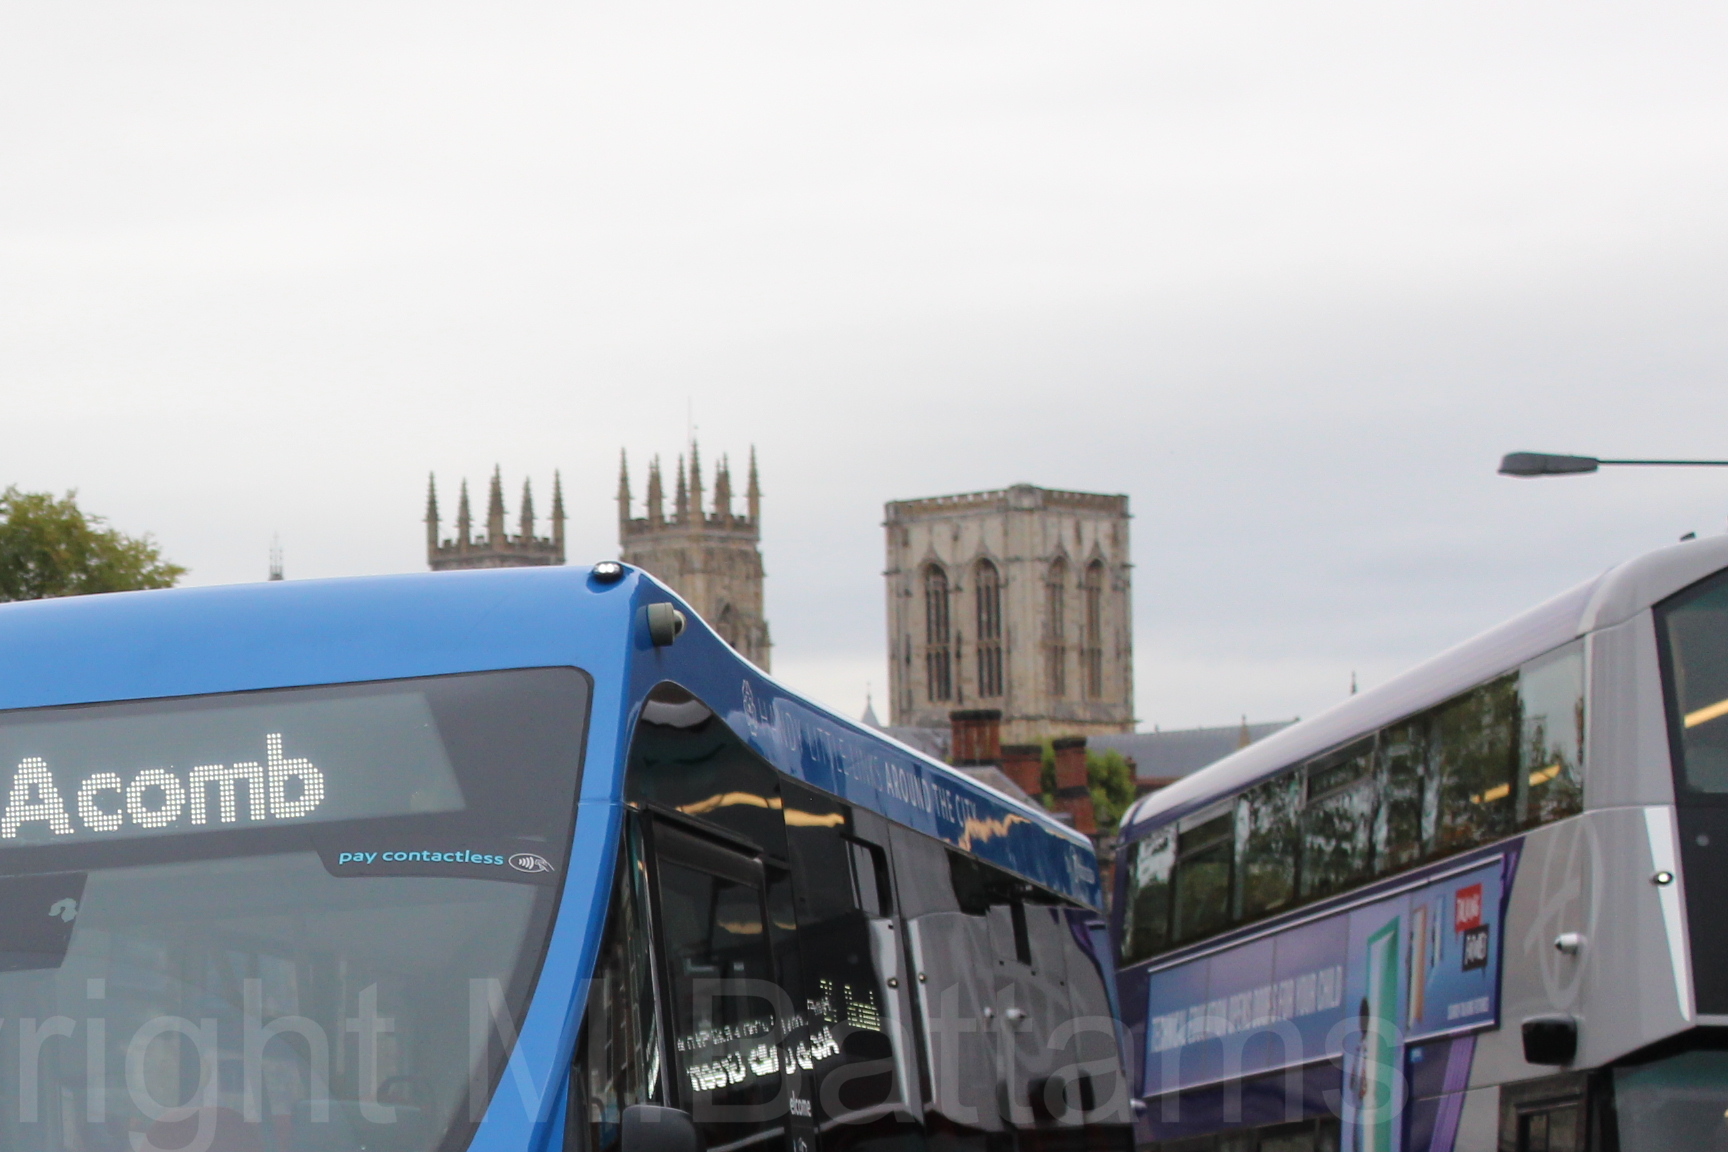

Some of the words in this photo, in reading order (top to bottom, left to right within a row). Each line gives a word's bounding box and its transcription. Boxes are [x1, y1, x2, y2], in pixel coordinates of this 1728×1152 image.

[0, 732, 325, 839] Acomb
[884, 761, 932, 814] AROUND
[931, 783, 956, 825] THE
[955, 794, 978, 829] CITY
[338, 850, 378, 865] pay
[381, 849, 505, 866] contactless
[789, 1089, 813, 1118] elcome
